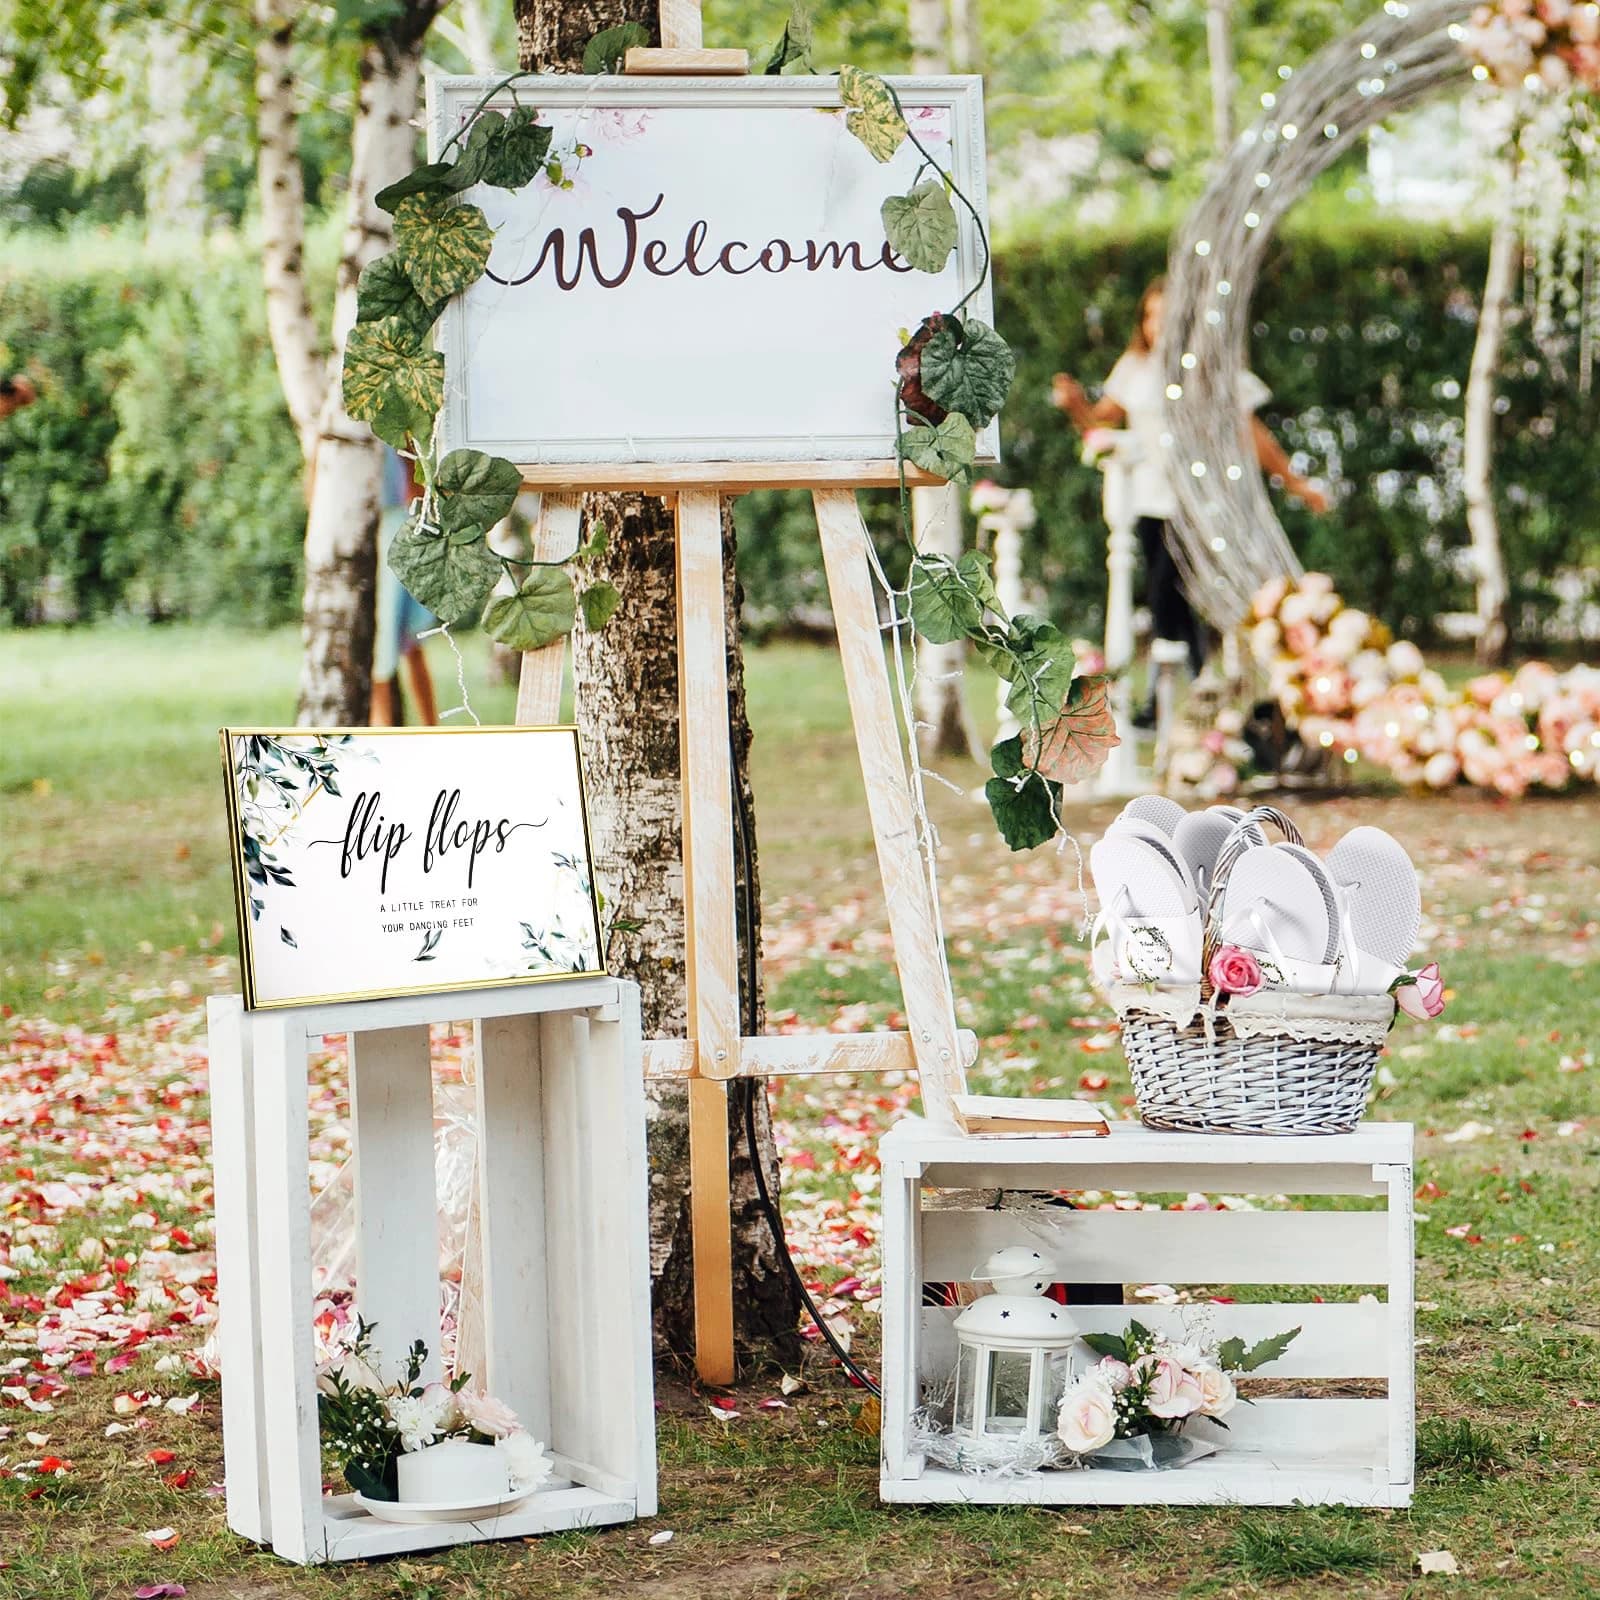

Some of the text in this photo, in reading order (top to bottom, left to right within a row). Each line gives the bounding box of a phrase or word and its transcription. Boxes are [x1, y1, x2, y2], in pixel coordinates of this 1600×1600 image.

[308, 787, 549, 895] flip flops
[379, 897, 478, 913] A LITTLE TREAT FOR
[381, 917, 474, 933] YOUR DANCING FEET
